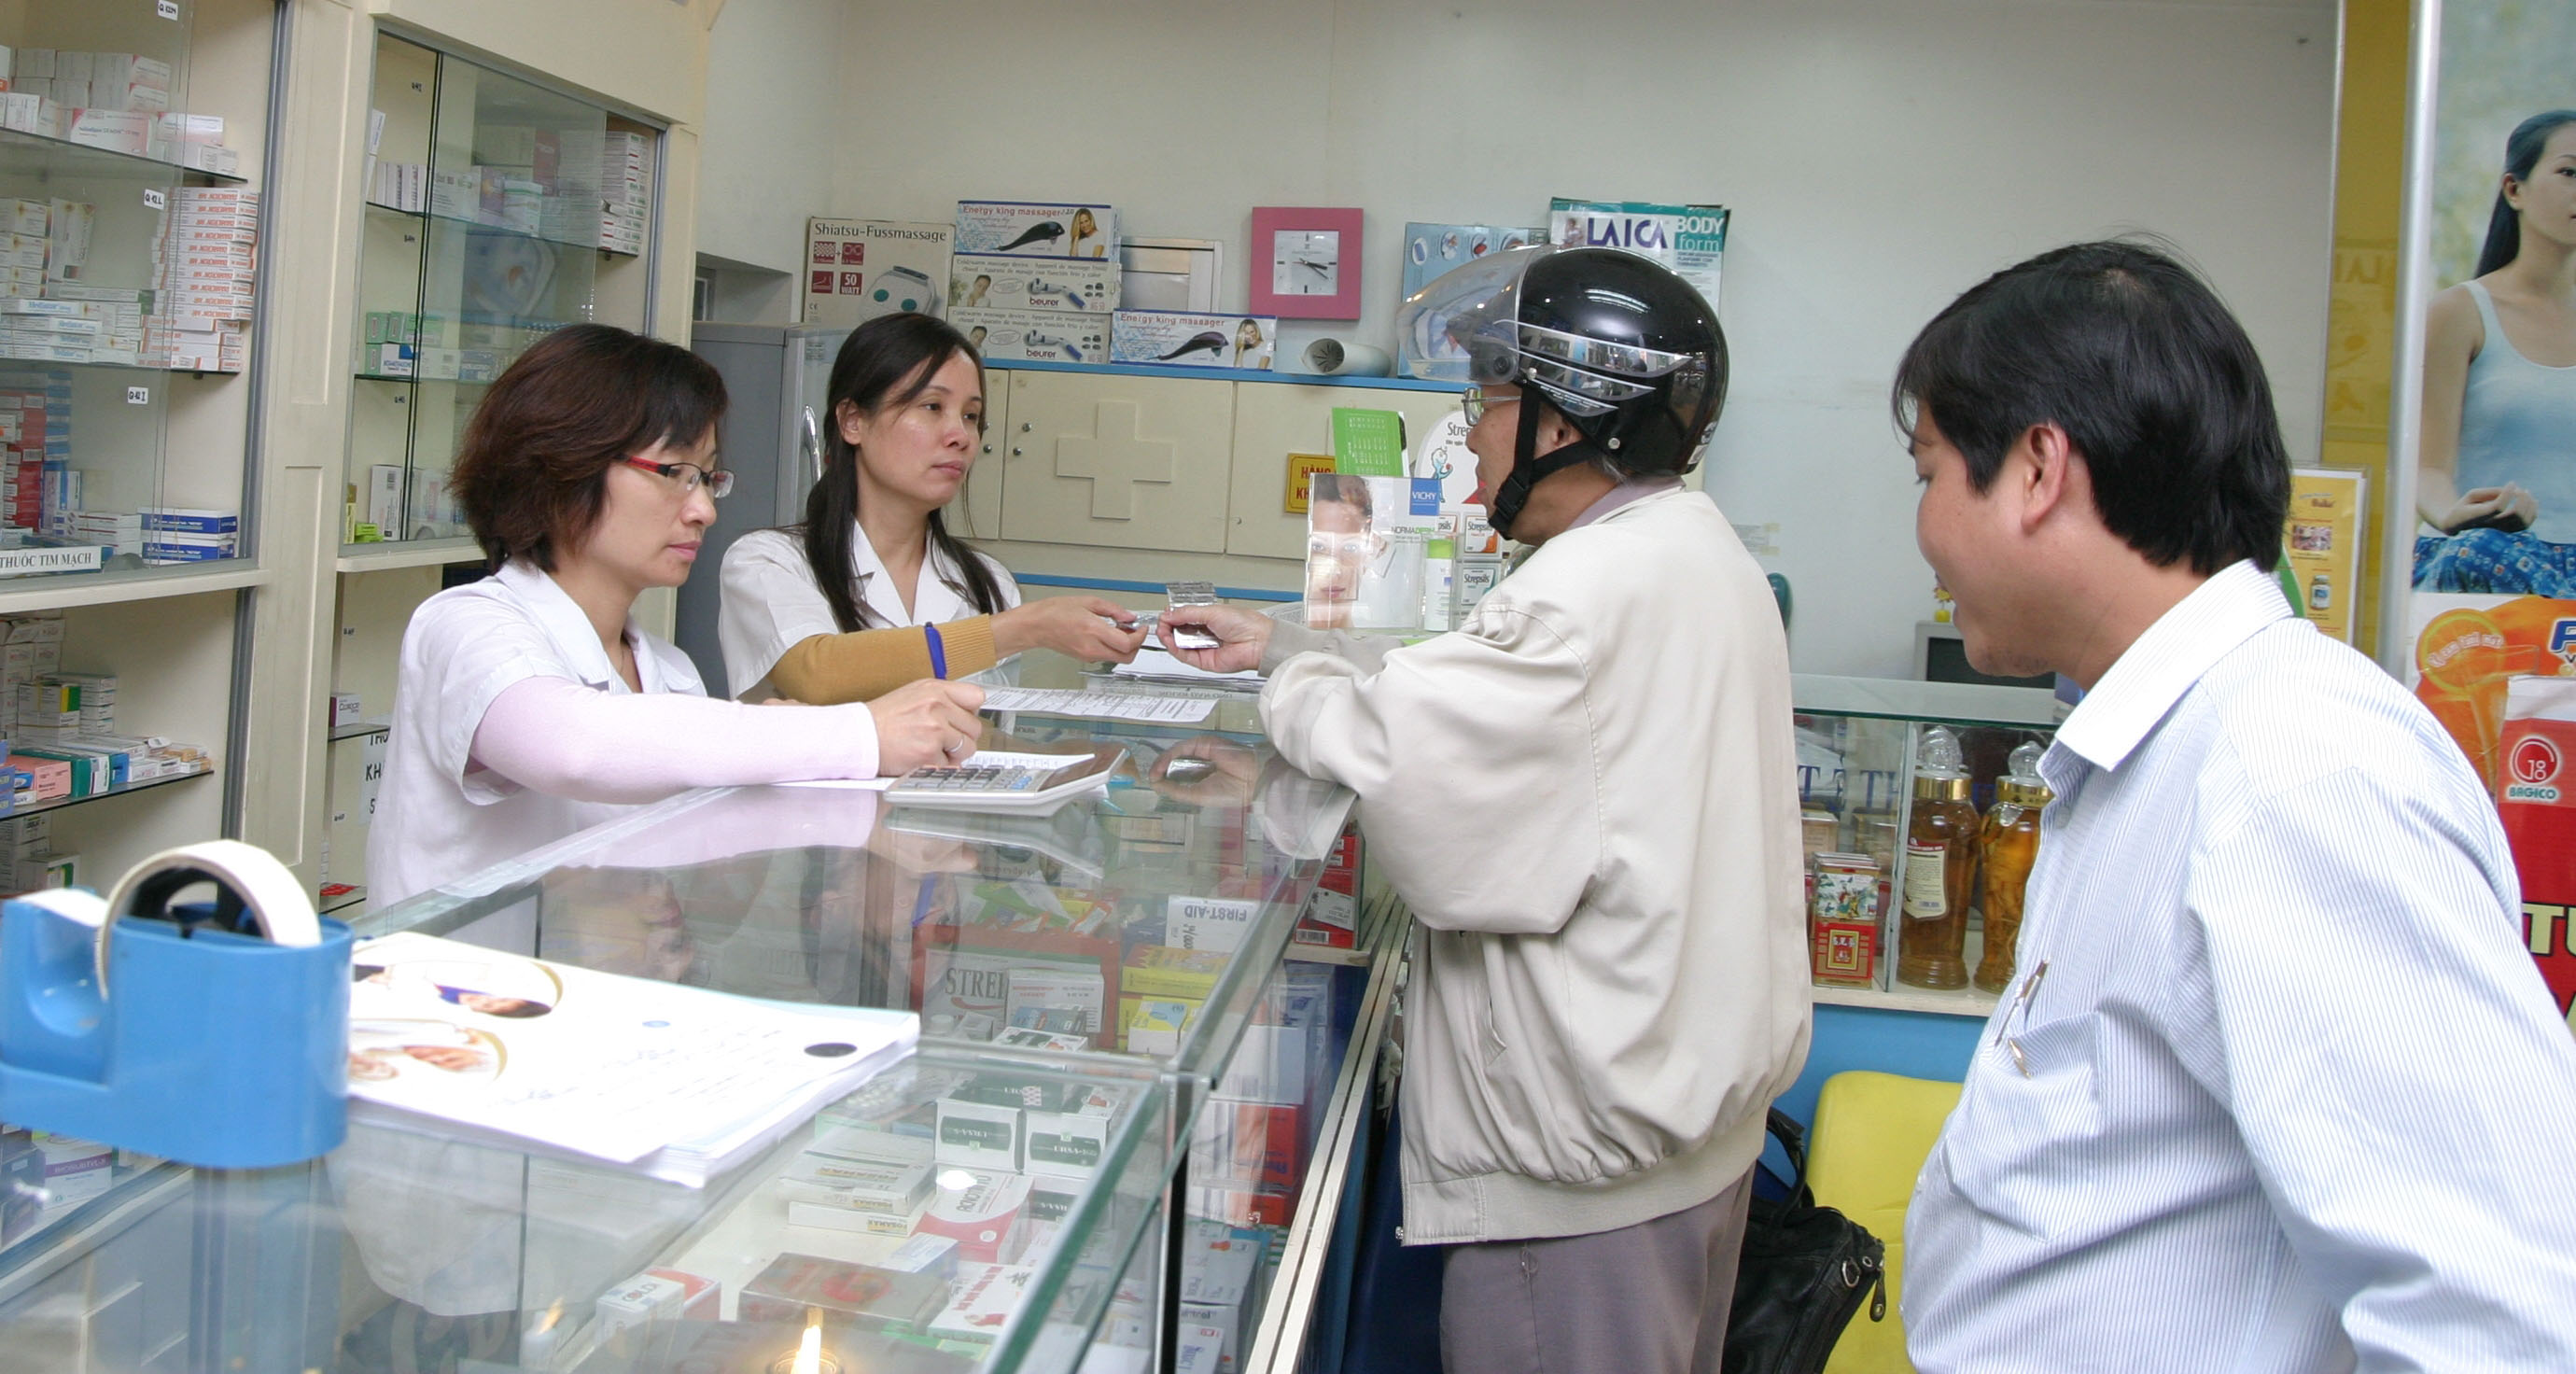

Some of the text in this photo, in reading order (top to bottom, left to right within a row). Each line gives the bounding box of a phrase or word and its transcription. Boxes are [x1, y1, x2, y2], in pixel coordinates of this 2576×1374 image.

[963, 205, 994, 216] Energy
[996, 207, 1015, 217] king
[1677, 216, 1725, 234] BODY
[815, 223, 946, 243] Shiatsu-Fussmassage
[1588, 217, 1668, 249] LAICA
[1679, 235, 1719, 251] form
[845, 273, 857, 286] 50
[1029, 297, 1059, 306] beurer
[1120, 314, 1225, 327] Energy king massager
[1026, 349, 1057, 358] beurer
[1411, 492, 1436, 500] VICHY
[39, 554, 59, 566] TIM
[62, 553, 91, 567] MẠCH
[1463, 573, 1491, 586] Strepsils
[2509, 787, 2555, 799] BAGICO
[1183, 904, 1247, 922] FIRST-AID
